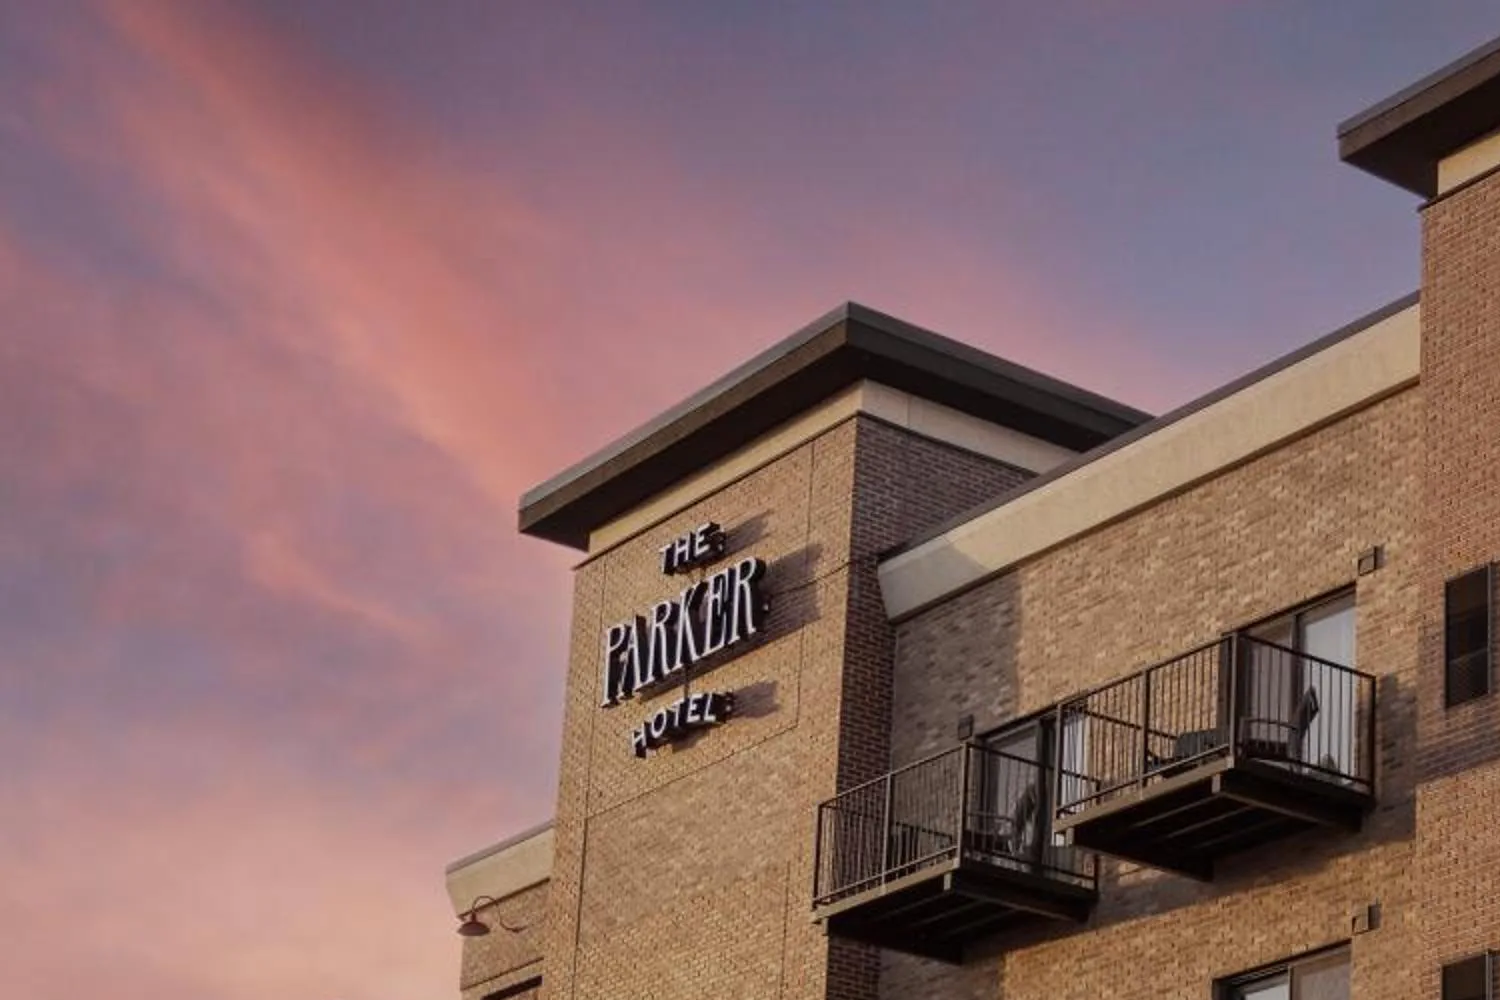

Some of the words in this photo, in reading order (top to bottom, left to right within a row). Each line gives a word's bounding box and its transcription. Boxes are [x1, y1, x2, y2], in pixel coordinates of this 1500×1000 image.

[659, 521, 715, 574] THE
[600, 556, 759, 708] PARKER
[631, 692, 718, 757] HOTEL
